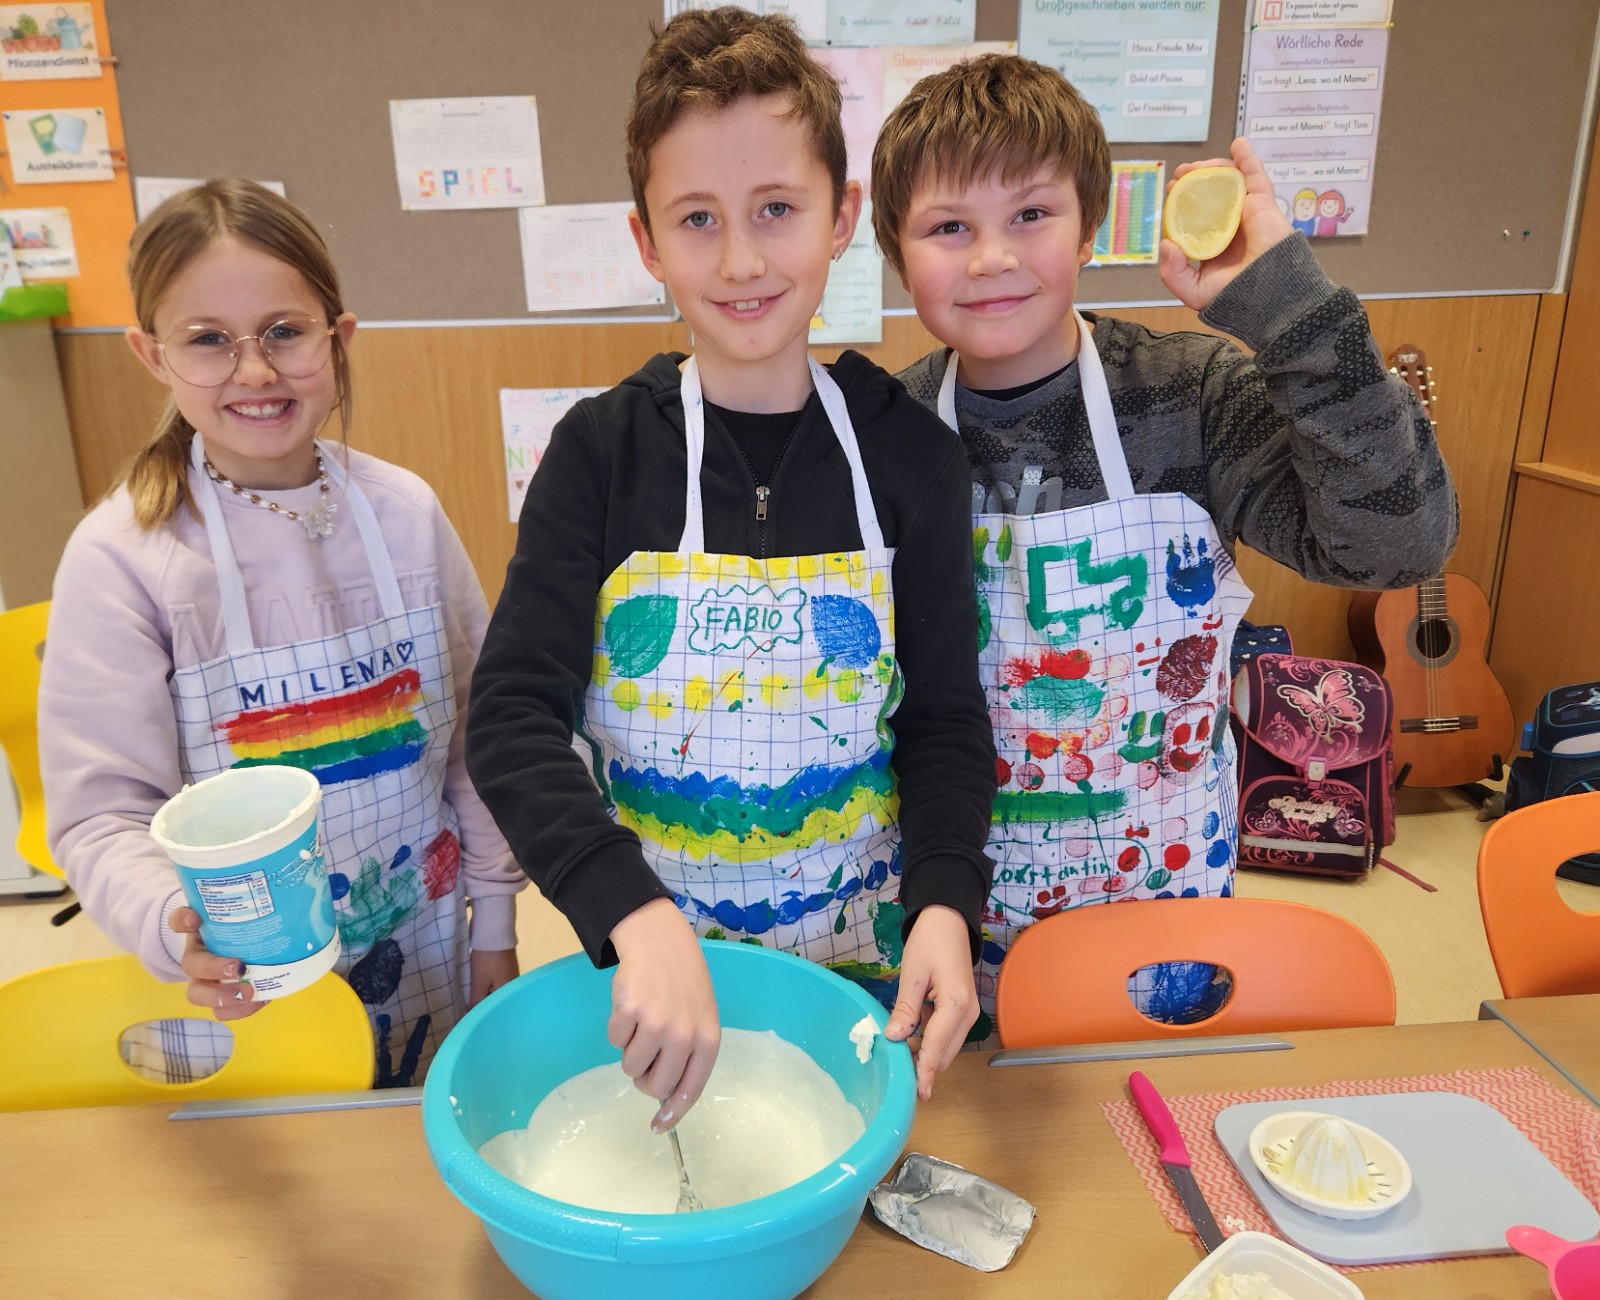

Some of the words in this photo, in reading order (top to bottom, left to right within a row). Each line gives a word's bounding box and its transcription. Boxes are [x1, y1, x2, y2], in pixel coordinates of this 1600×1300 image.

[1139, 0, 1180, 10] werden
[1184, 1, 1206, 11] nur:
[1276, 34, 1331, 49] Wörtliche
[1334, 33, 1363, 47] Rede
[1132, 43, 1154, 52] Haus,
[1157, 43, 1184, 53] Freude,
[1187, 43, 1202, 51] Max
[1130, 74, 1147, 83] Bald
[1149, 74, 1159, 82] ist
[1257, 76, 1272, 85] Tom
[1333, 74, 1342, 83] ist
[1128, 103, 1141, 112] Der
[1290, 122, 1298, 131] ist
[704, 605, 783, 640] FABIO
[239, 648, 395, 710] MILENA
